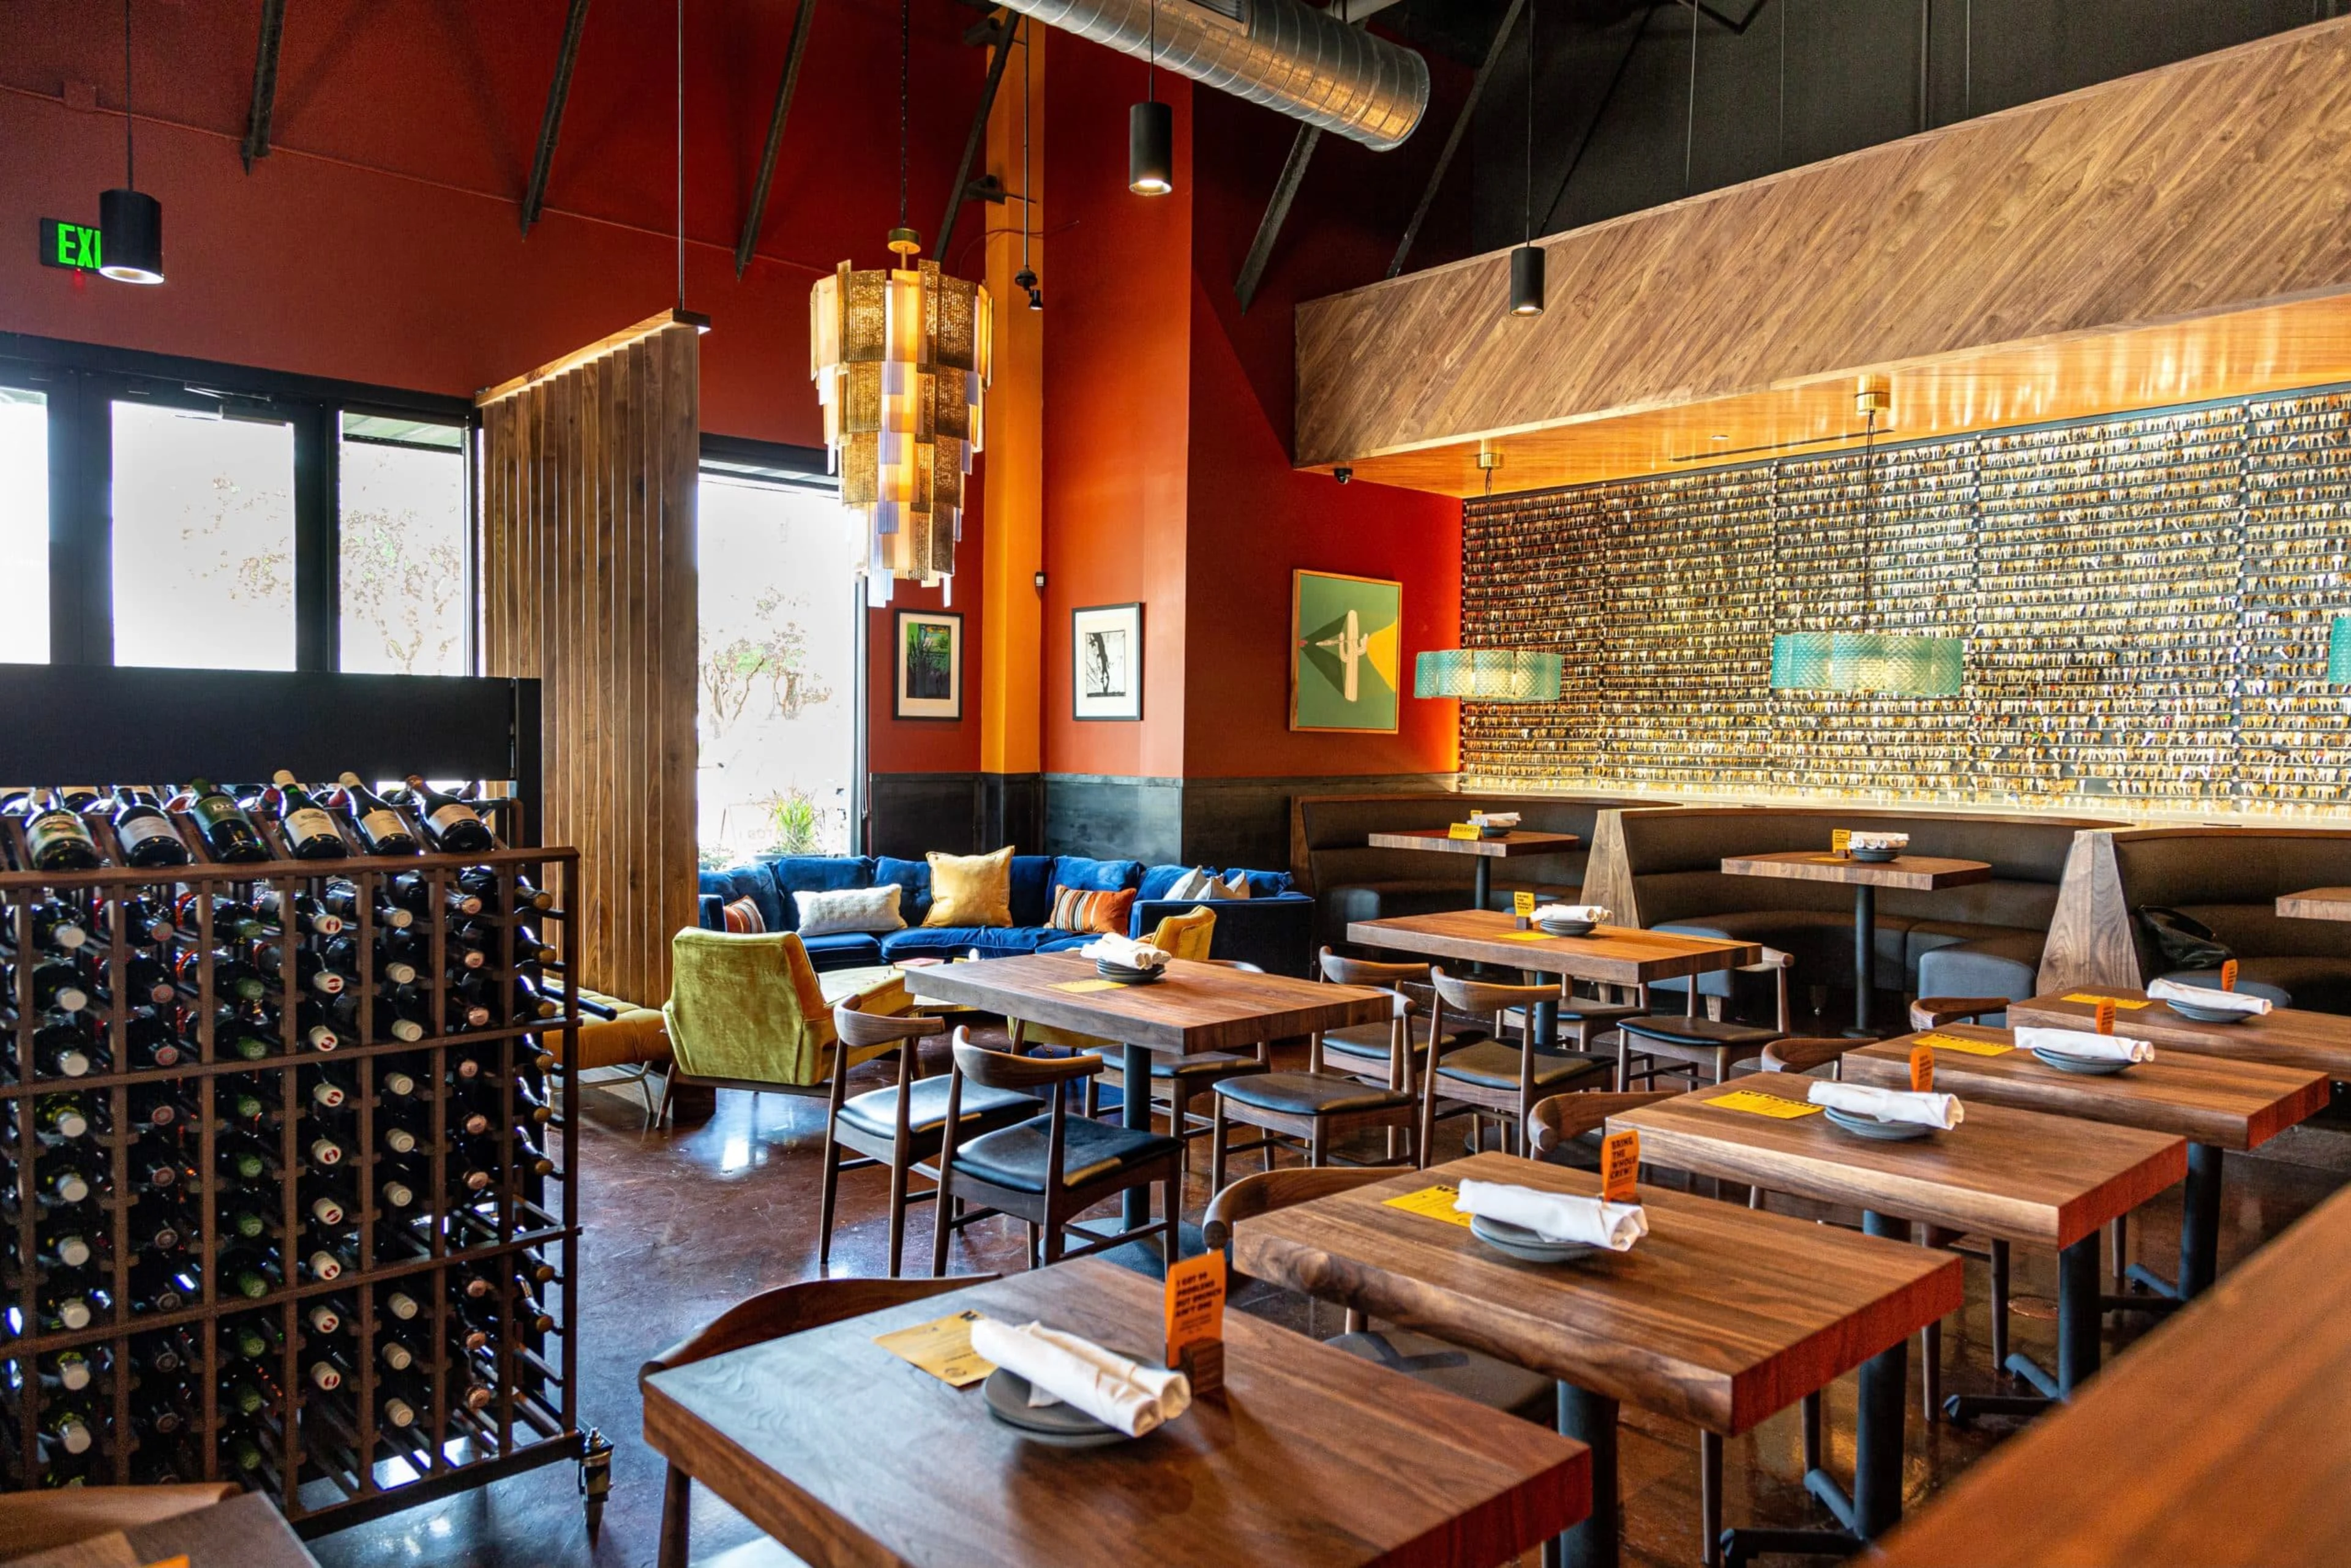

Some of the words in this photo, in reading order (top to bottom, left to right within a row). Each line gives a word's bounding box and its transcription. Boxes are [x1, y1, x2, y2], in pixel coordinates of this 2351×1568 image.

[58, 223, 101, 269] EXI
[1611, 1136, 1633, 1150] BRING
[1612, 1149, 1625, 1161] THE
[1612, 1155, 1637, 1169] WHOLE
[1610, 1166, 1633, 1179] CREW!
[1182, 1275, 1196, 1286] GOT
[1177, 1280, 1215, 1297] PROBLEMS
[1176, 1297, 1191, 1308] BUT
[1193, 1288, 1223, 1303] BRUNCH
[1175, 1305, 1196, 1318] AIN'T
[1197, 1299, 1212, 1311] ONE
